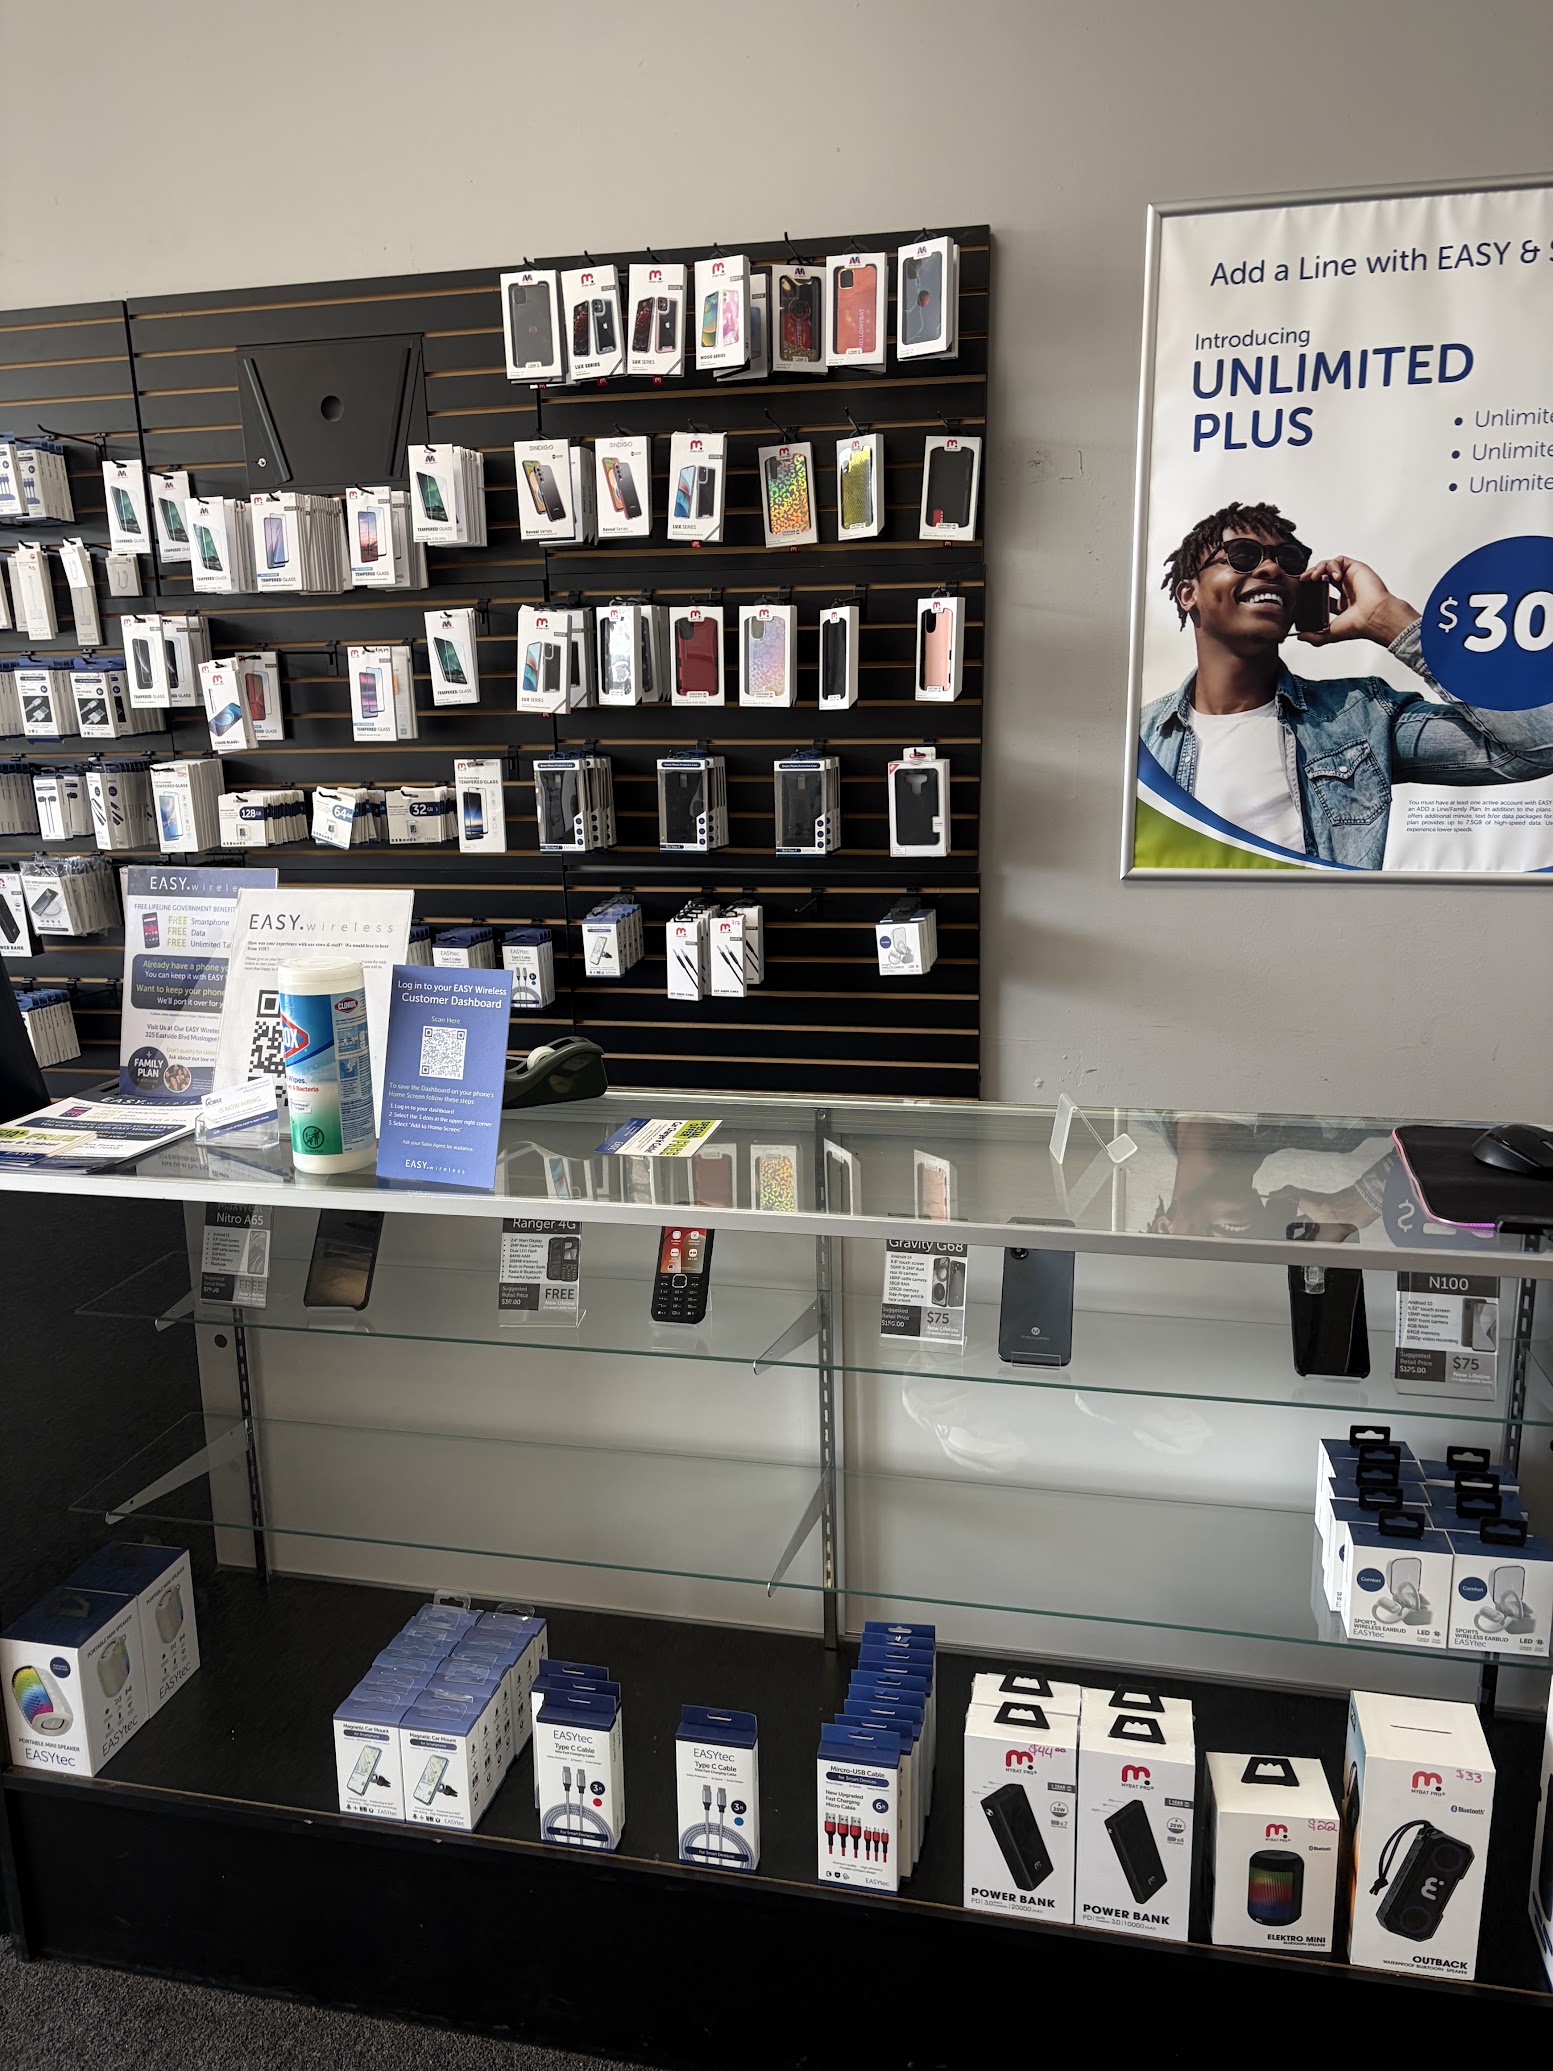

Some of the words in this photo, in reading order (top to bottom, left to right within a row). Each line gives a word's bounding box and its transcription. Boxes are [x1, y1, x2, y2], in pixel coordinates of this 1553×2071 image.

[1210, 260, 1266, 287] Add
[1274, 263, 1289, 281] a
[1299, 254, 1357, 280] Line
[1366, 249, 1427, 274] with
[1438, 241, 1511, 270] EASY
[1519, 239, 1541, 264] &
[1195, 328, 1311, 351] Introducing
[1192, 343, 1474, 400] UNLIMITED
[1193, 407, 1314, 452] PLUS
[150, 876, 243, 892] EASY.wirele
[168, 916, 188, 925] FREE
[191, 918, 229, 926] Smartphone
[167, 927, 187, 936] FREE
[191, 929, 206, 937] Data
[167, 938, 186, 947] FREE
[190, 941, 220, 949] Unlimited
[143, 960, 170, 969] Already
[172, 961, 188, 970] have
[196, 963, 219, 971] phone
[171, 972, 186, 981] keep
[136, 984, 155, 993] Want
[156, 985, 164, 994] to
[166, 985, 183, 996] keep
[185, 987, 201, 996] your
[398, 980, 412, 990] Log
[434, 985, 451, 993] your
[453, 984, 473, 993] EASY
[475, 986, 507, 995] Wireless
[338, 1001, 357, 1010] CLOROX
[402, 993, 448, 1005] Customer
[451, 996, 502, 1008] Dashboard
[134, 1058, 163, 1068] FAMILY
[138, 1068, 159, 1078] PLAN
[216, 1213, 242, 1224] Nitro
[244, 1214, 264, 1226] A65
[512, 1219, 557, 1232] Ranger
[558, 1220, 576, 1230] 4G
[889, 1240, 933, 1252] Gravity
[937, 1242, 963, 1252] G68
[239, 1280, 264, 1291] FREE
[1429, 1277, 1469, 1291] N100
[545, 1288, 574, 1299] FREE
[927, 1311, 949, 1324] $75
[1453, 1356, 1479, 1370] $75
[1361, 1576, 1382, 1584] Comfort
[1462, 1585, 1484, 1593] Comfort
[1353, 1629, 1385, 1638] EASYtec
[1354, 1623, 1381, 1632] WIRELESS
[1382, 1626, 1406, 1634] EARBUD
[1454, 1638, 1487, 1648] EASYtec
[1455, 1633, 1483, 1641] WIRELESS
[1484, 1635, 1509, 1643] EARBUD
[343, 1723, 363, 1731] Magnetic
[373, 1726, 389, 1734] Mount
[102, 1715, 138, 1757] EASYtec
[409, 1732, 431, 1740] Magnetic
[553, 1729, 593, 1744] EASYtec
[19, 1737, 44, 1747] PORTABLE
[57, 1744, 80, 1752] SPEAKER
[554, 1743, 570, 1751] Type
[576, 1745, 595, 1754] Cable
[25, 1748, 76, 1767] EASYtec
[693, 1748, 735, 1762] EASYtec
[695, 1761, 711, 1770] Type
[718, 1764, 737, 1773] Cable
[831, 1765, 866, 1776] Mircro-USB
[867, 1770, 885, 1778] Cable
[1456, 1769, 1483, 1783] $33
[825, 1789, 837, 1797] New
[838, 1791, 864, 1801] Upgraded
[825, 1795, 836, 1803] Fast
[836, 1798, 861, 1807] Charging
[825, 1802, 839, 1810] Micro
[1458, 1806, 1485, 1815] Bluetooth
[377, 1809, 398, 1818] EASYtec
[444, 1818, 465, 1827] EASYtec
[1308, 1819, 1338, 1831] $22
[865, 1877, 890, 1887] EASYtec
[971, 1888, 1017, 1903] POWER
[1020, 1895, 1056, 1908] BANK
[1083, 1903, 1130, 1919] POWER
[1133, 1911, 1170, 1926] BANK
[1267, 1934, 1304, 1943] ELEKTRO
[1305, 1936, 1326, 1944] MINI
[1383, 1959, 1414, 1968] WATERPROOF
[1416, 1964, 1444, 1972] BLUETOOTH
[1412, 1955, 1468, 1970] OUTBACK
